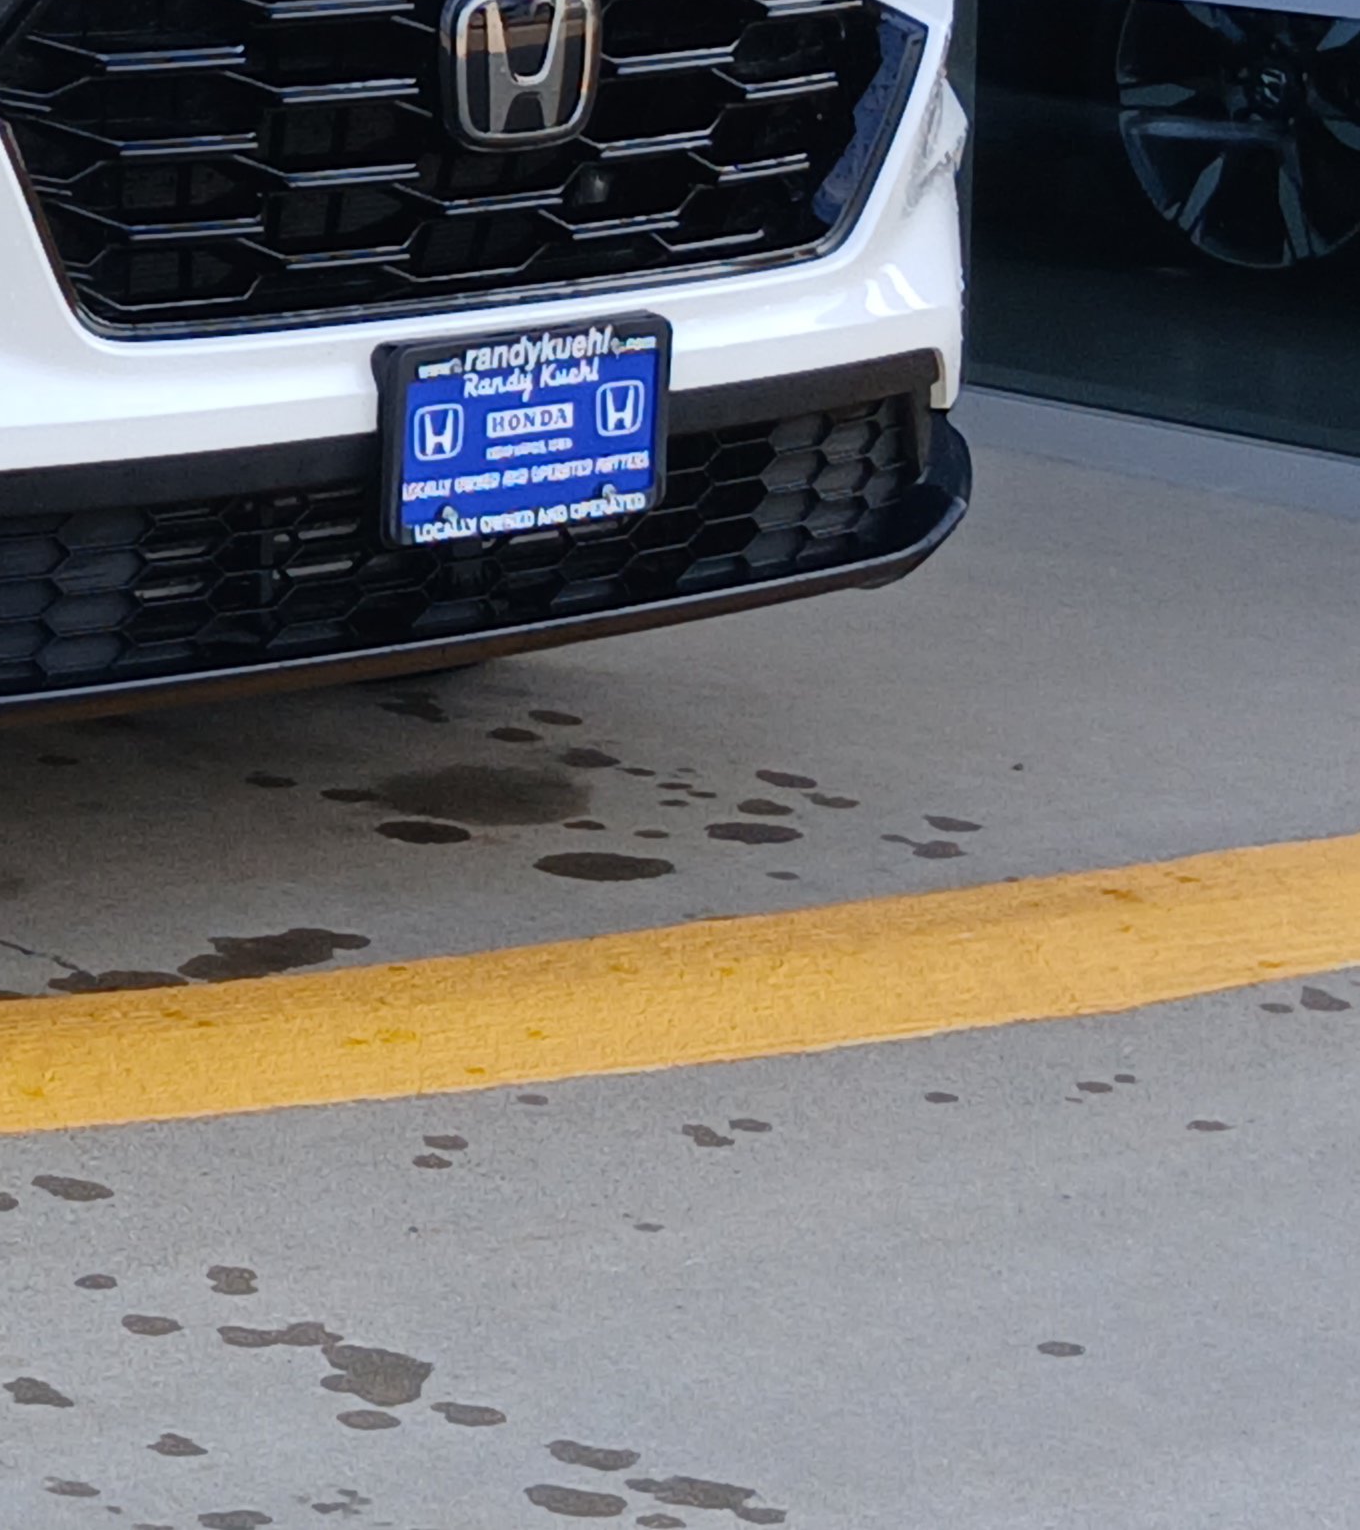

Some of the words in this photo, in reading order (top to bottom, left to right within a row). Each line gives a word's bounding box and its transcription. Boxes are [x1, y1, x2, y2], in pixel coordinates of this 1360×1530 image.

[463, 368, 534, 402] Randy
[491, 407, 568, 434] HONDA
[402, 478, 453, 502] LOCALLY
[414, 517, 478, 543] LOCALLY
[480, 510, 534, 534] OWNED
[537, 504, 568, 527] AND
[570, 492, 646, 520] OPERATED
